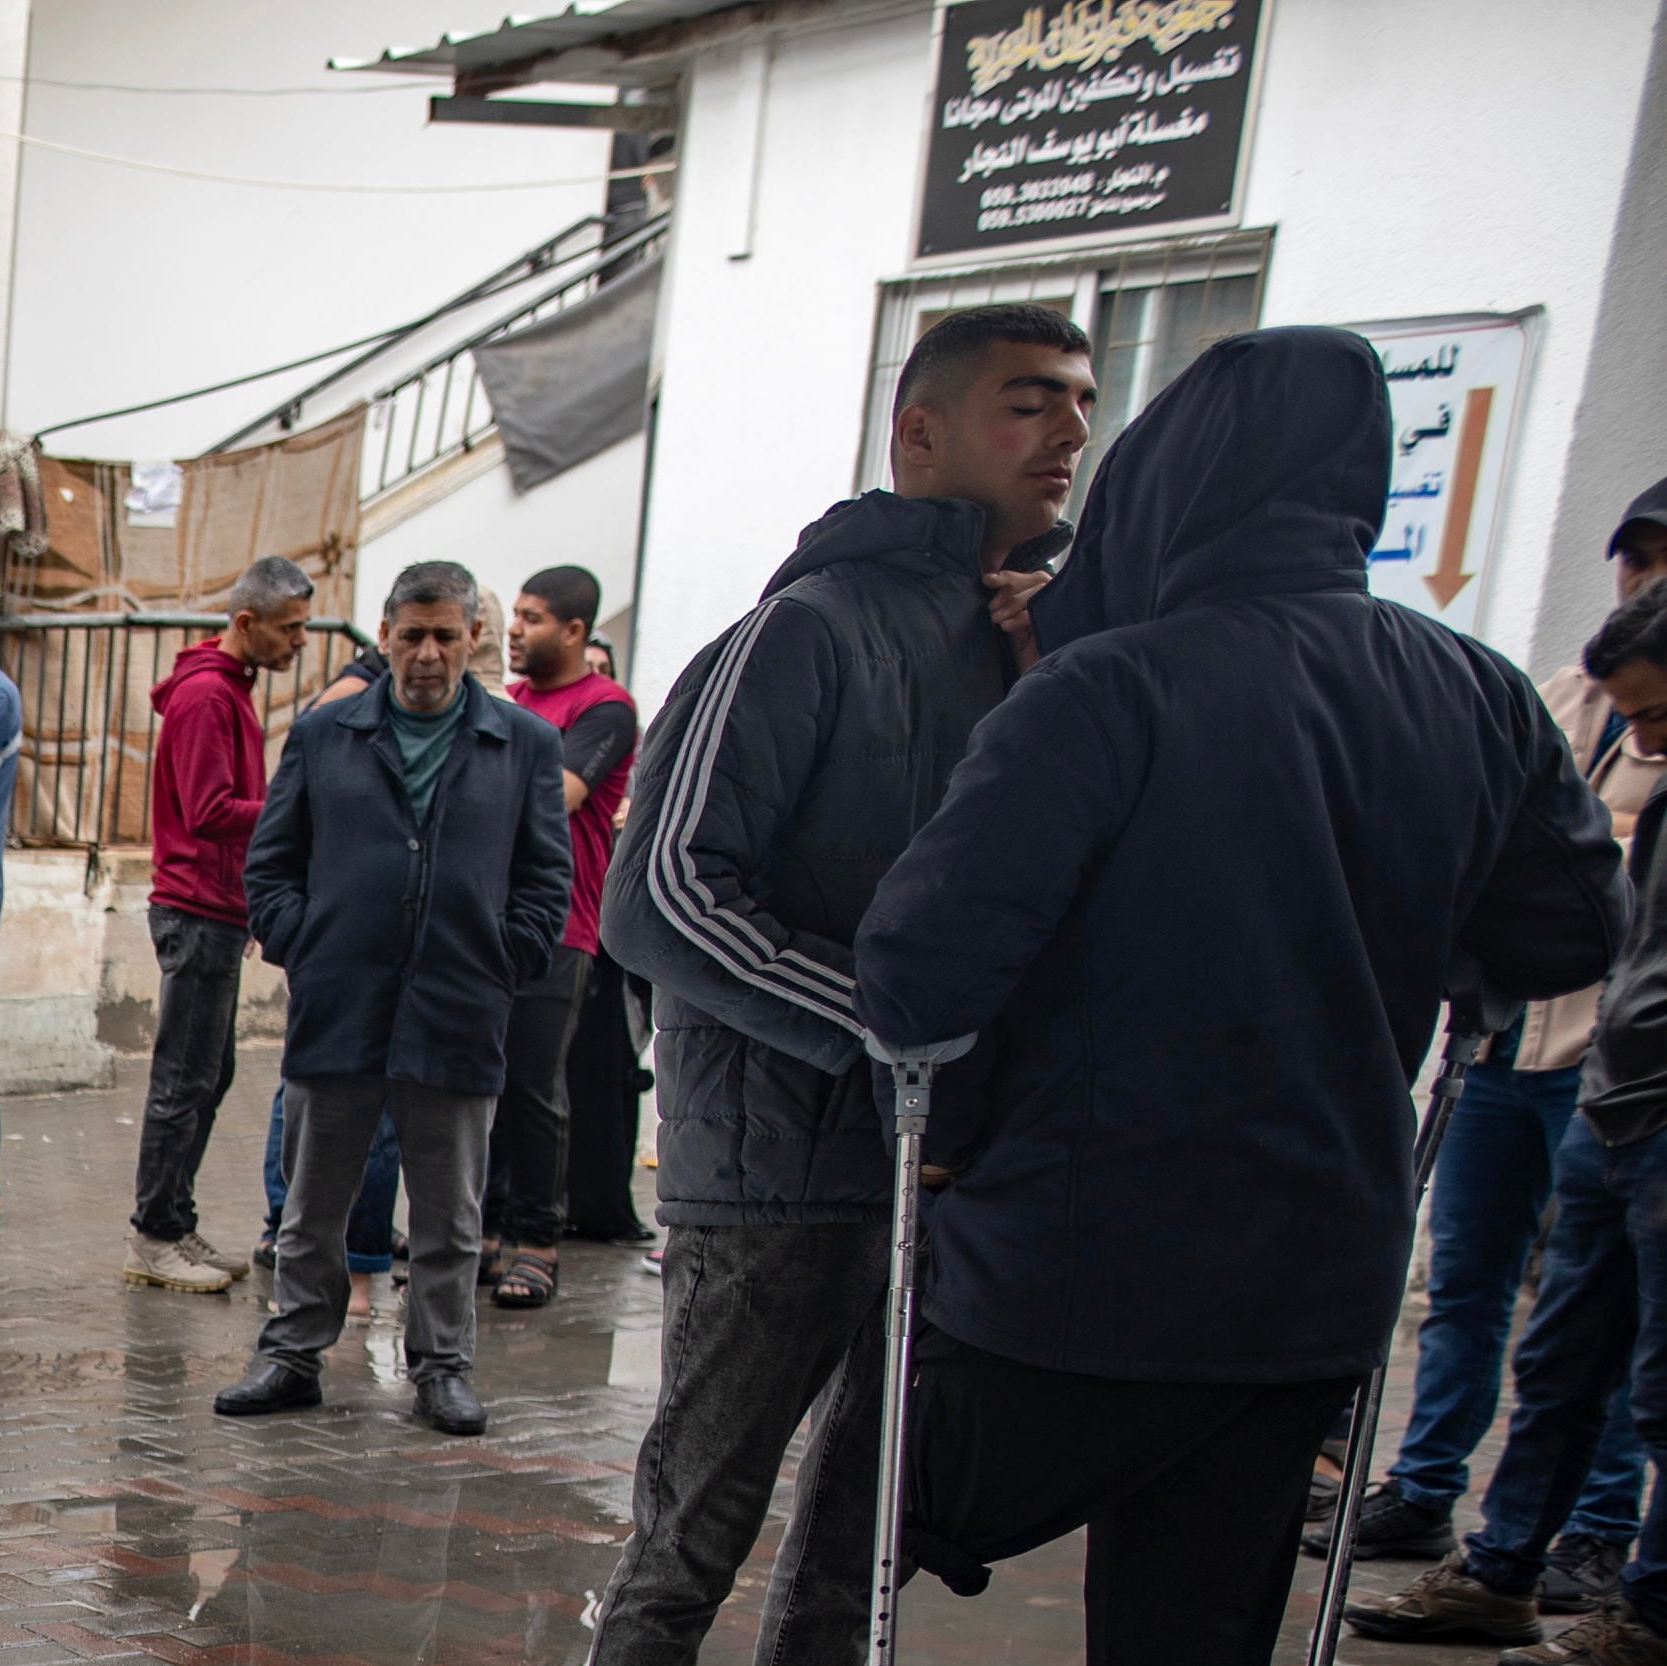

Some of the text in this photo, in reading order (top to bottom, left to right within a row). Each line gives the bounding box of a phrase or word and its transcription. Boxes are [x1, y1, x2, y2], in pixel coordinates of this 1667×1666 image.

[1156, 44, 1243, 95] تغسيل
[942, 94, 1000, 130] مجانا
[1127, 104, 1211, 146] مغسلة
[956, 132, 1030, 184] النجار
[1026, 126, 1097, 166] يوسف
[1398, 402, 1453, 457] في
